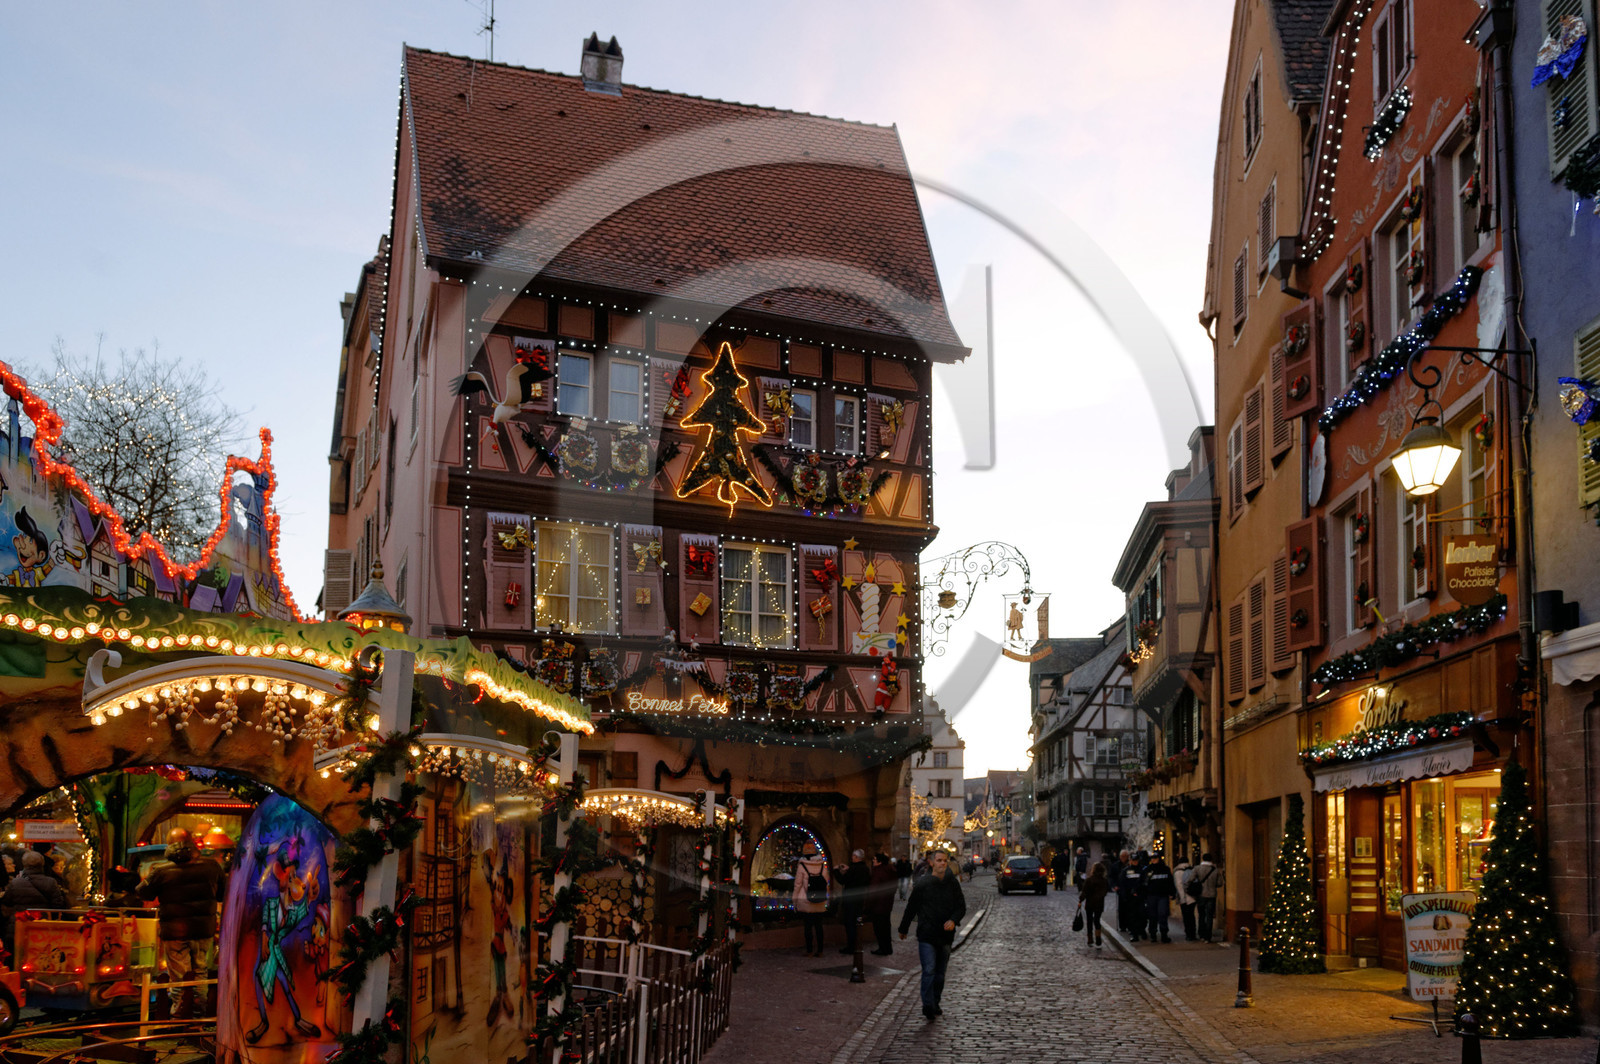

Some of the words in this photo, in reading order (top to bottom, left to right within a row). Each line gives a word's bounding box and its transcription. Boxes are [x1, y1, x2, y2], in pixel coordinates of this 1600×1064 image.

[1445, 540, 1496, 565] Lorber
[1449, 577, 1497, 589] Chocolatier
[1354, 683, 1404, 734] Lorber
[1404, 902, 1424, 919] NOS
[1415, 986, 1446, 996] VENTE
